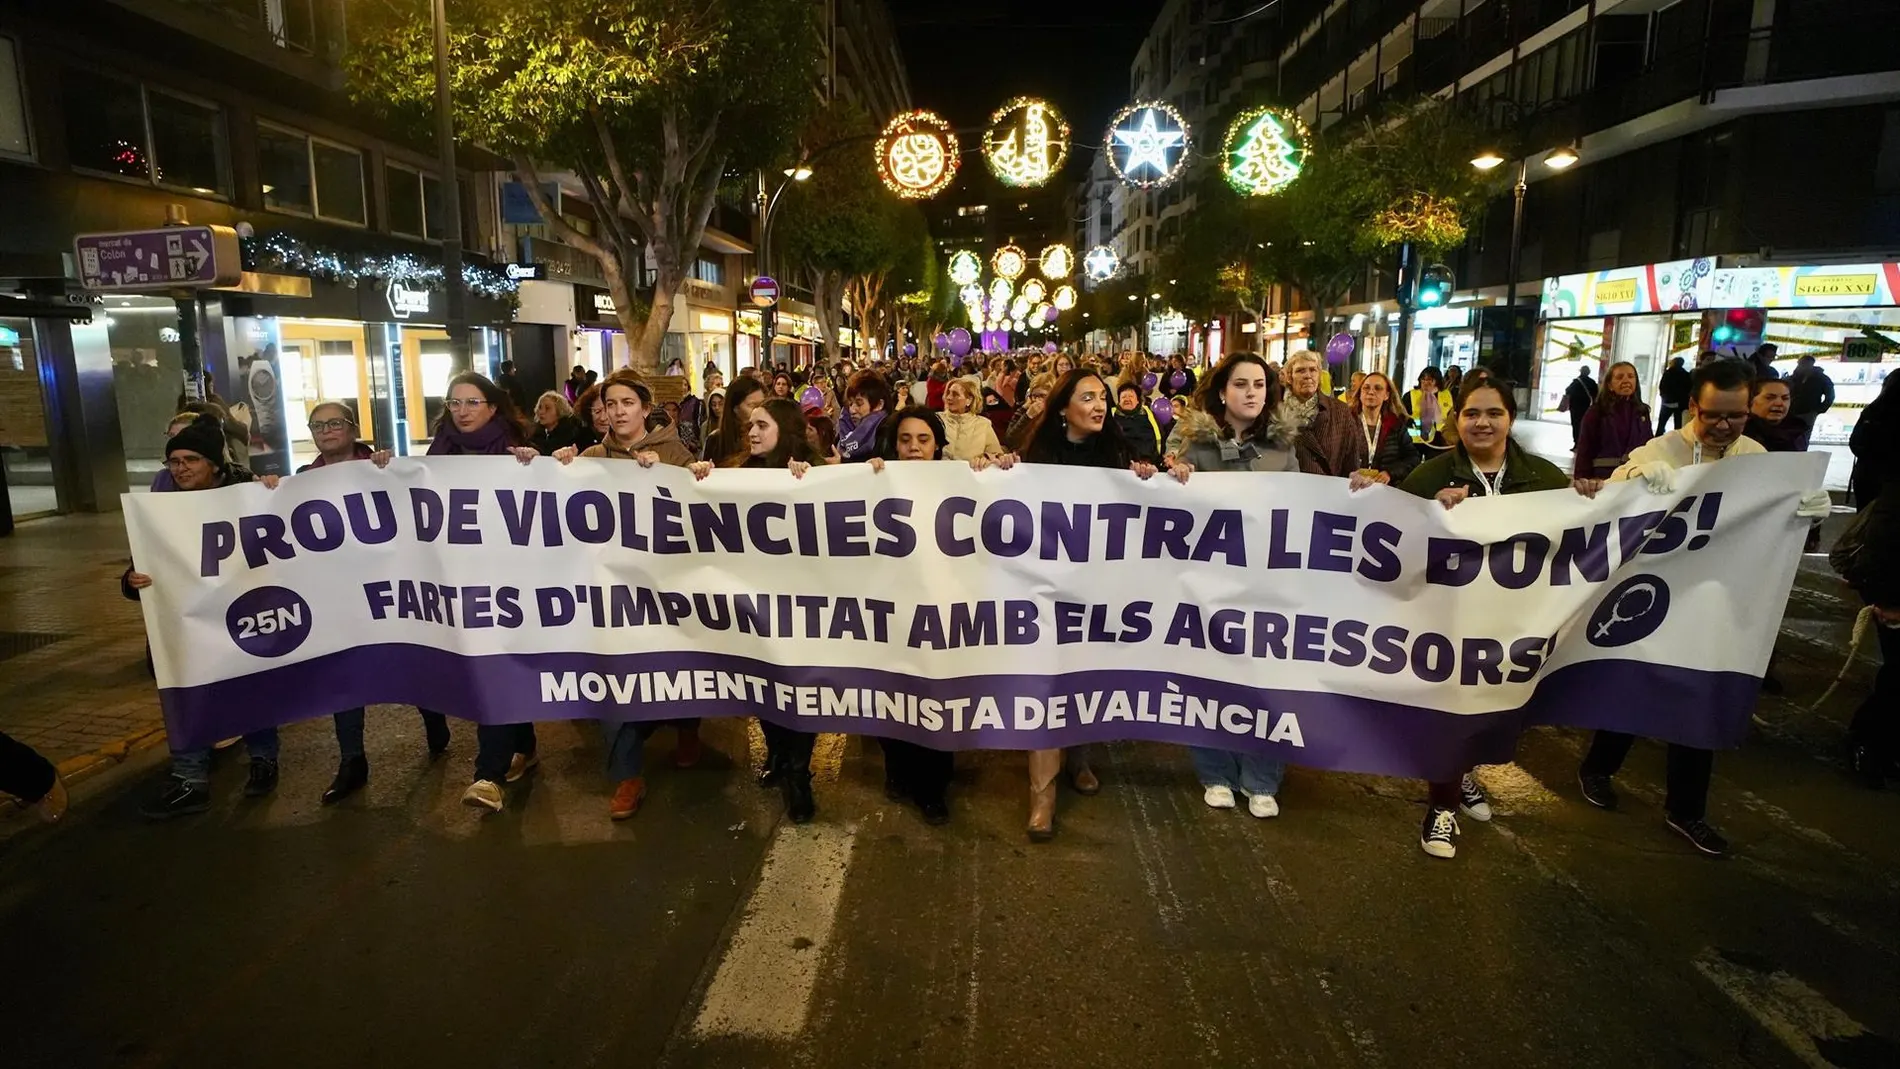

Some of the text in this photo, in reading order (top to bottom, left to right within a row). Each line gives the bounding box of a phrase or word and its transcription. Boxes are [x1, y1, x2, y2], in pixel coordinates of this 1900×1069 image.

[1596, 290, 1618, 301] SIGLO
[1798, 283, 1871, 293] SIGLO XXI
[201, 485, 1723, 589] PROU DE VIOLÈNCIES CONTRA LES DONES!
[236, 602, 303, 640] 25N
[363, 579, 524, 629] FARTES
[536, 584, 895, 644] D'IMPUNITAT
[907, 599, 1040, 650] AMB
[1053, 600, 1153, 645] ELS
[540, 669, 1305, 748] MOVIMENT FEMINISTA DE VALÈNCIA
